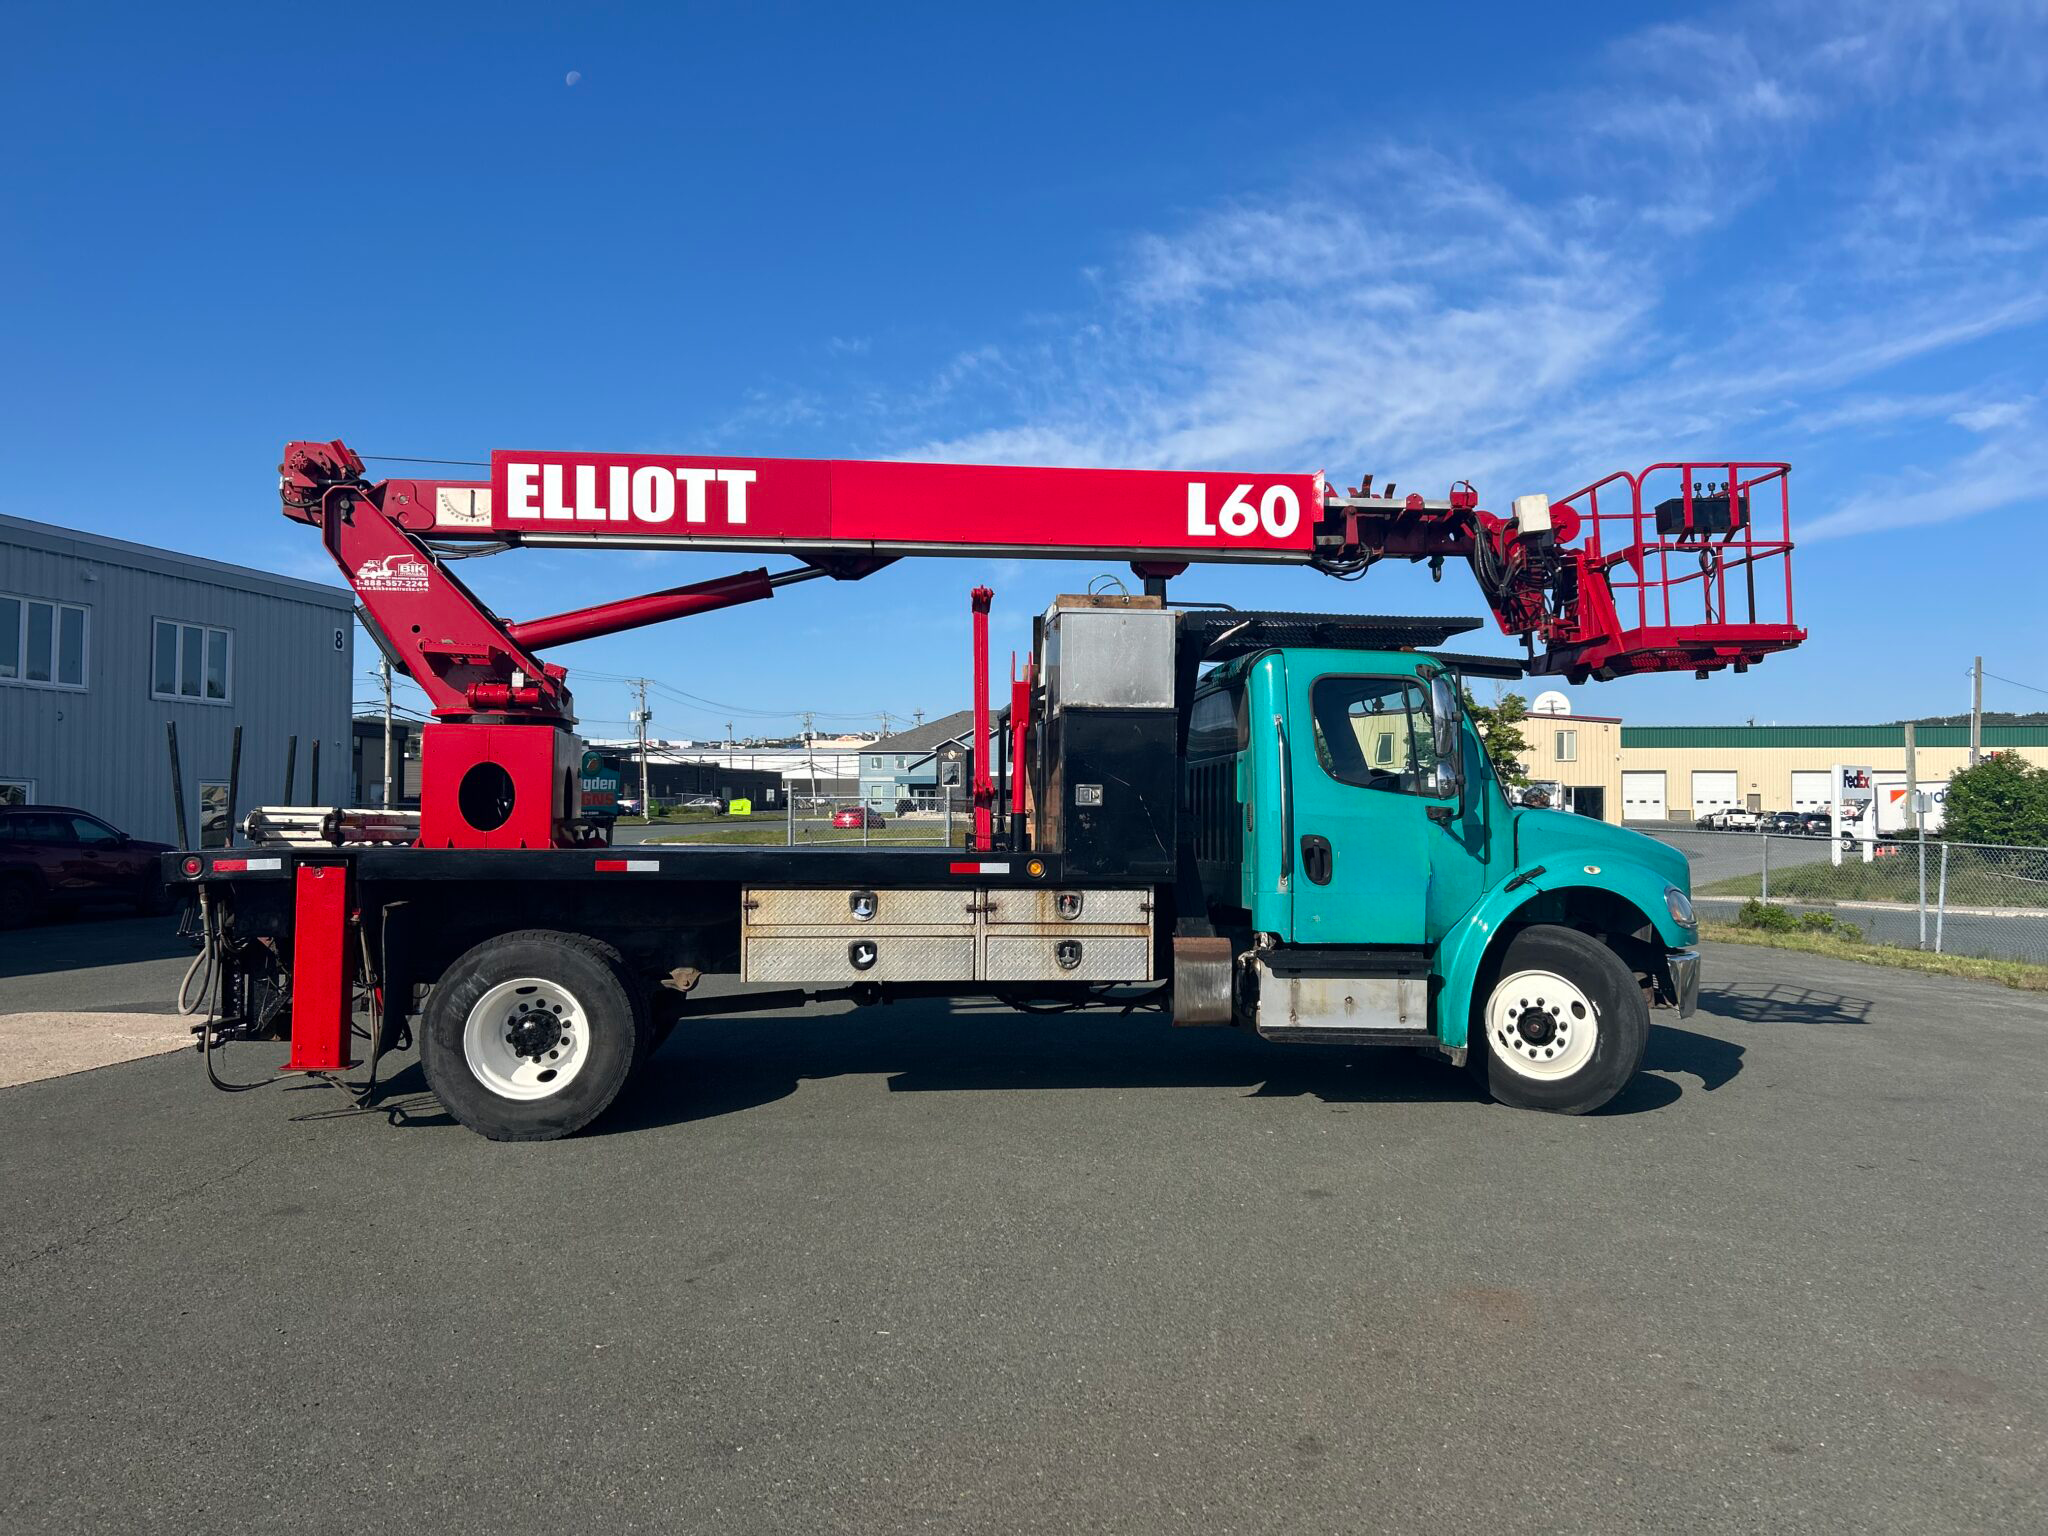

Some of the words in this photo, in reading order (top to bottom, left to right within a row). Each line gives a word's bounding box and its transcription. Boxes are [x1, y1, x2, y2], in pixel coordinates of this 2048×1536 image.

[507, 462, 757, 524] ELLIOTT
[1187, 482, 1300, 538] L60
[400, 564, 426, 573] BIK
[356, 579, 429, 587] 1-888-557-2244
[335, 630, 343, 650] 8
[1843, 769, 1870, 789] FedEx
